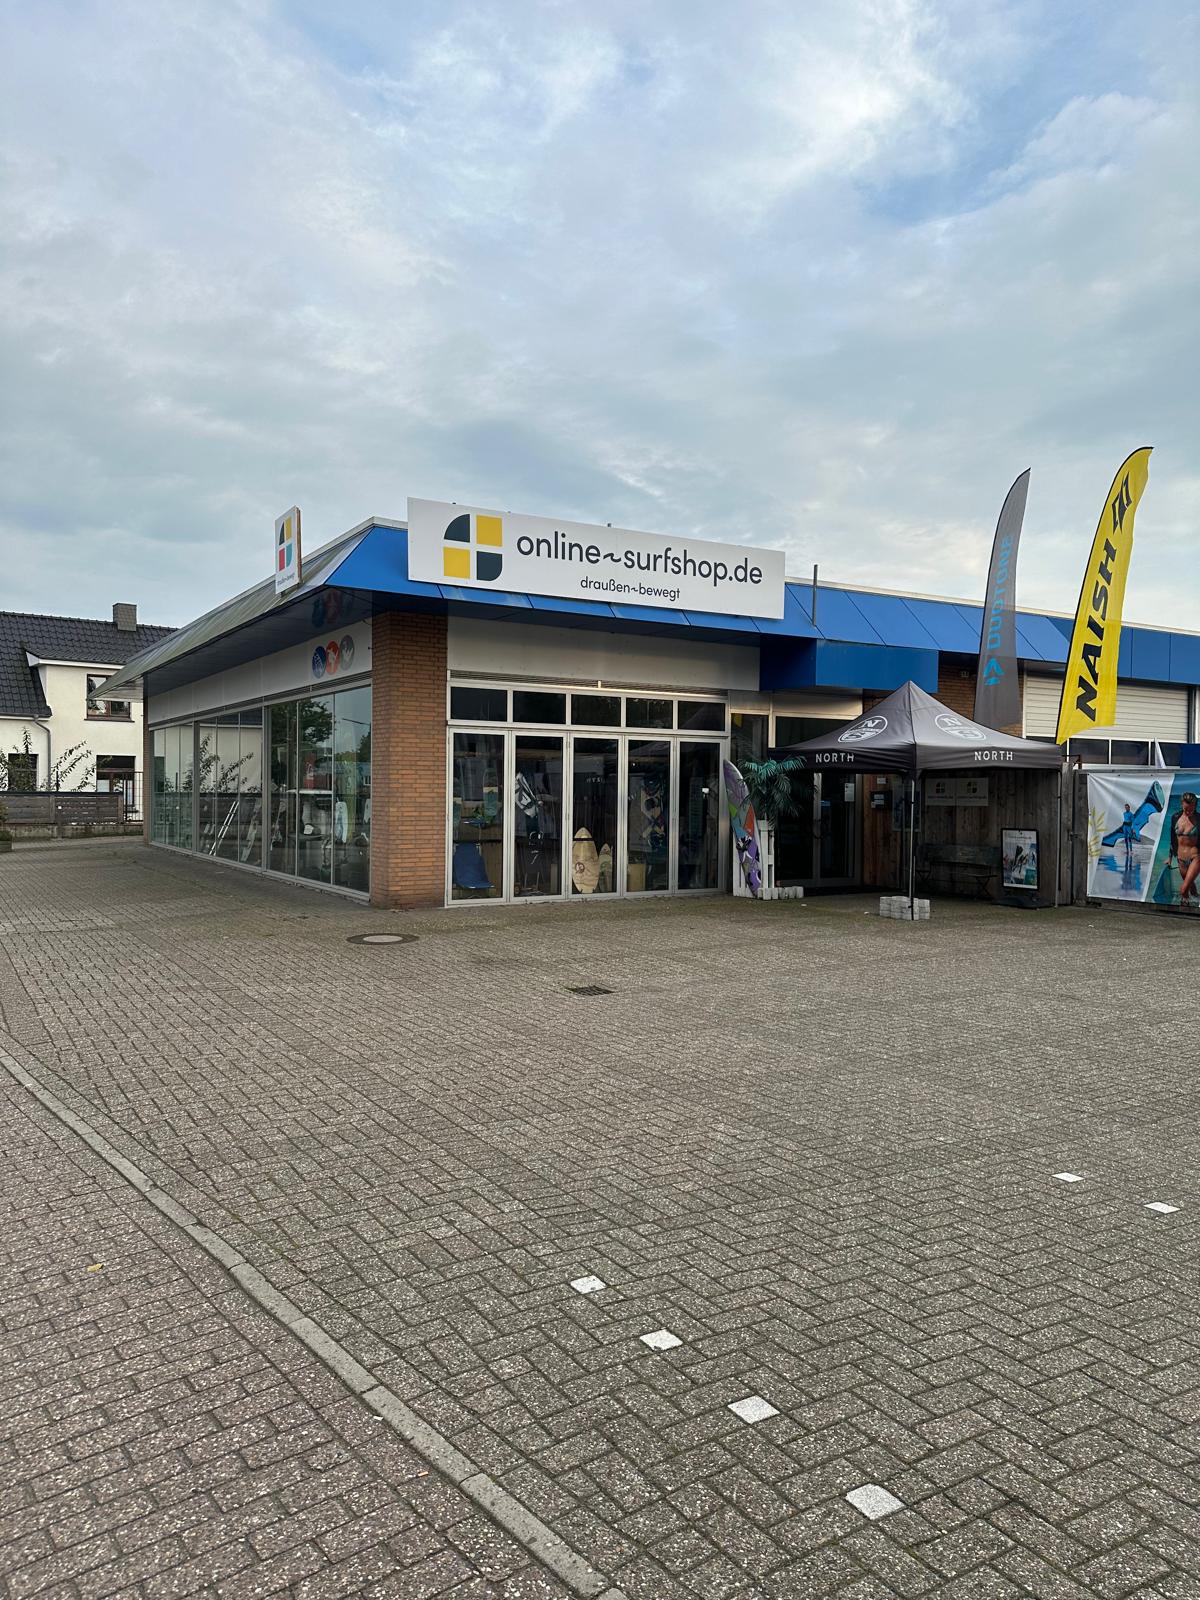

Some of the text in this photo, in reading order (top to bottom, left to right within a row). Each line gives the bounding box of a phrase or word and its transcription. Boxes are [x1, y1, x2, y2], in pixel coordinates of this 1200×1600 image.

[1076, 538, 1117, 722] NAISH
[815, 753, 855, 763] NORTH
[974, 750, 1013, 761] NORTH
